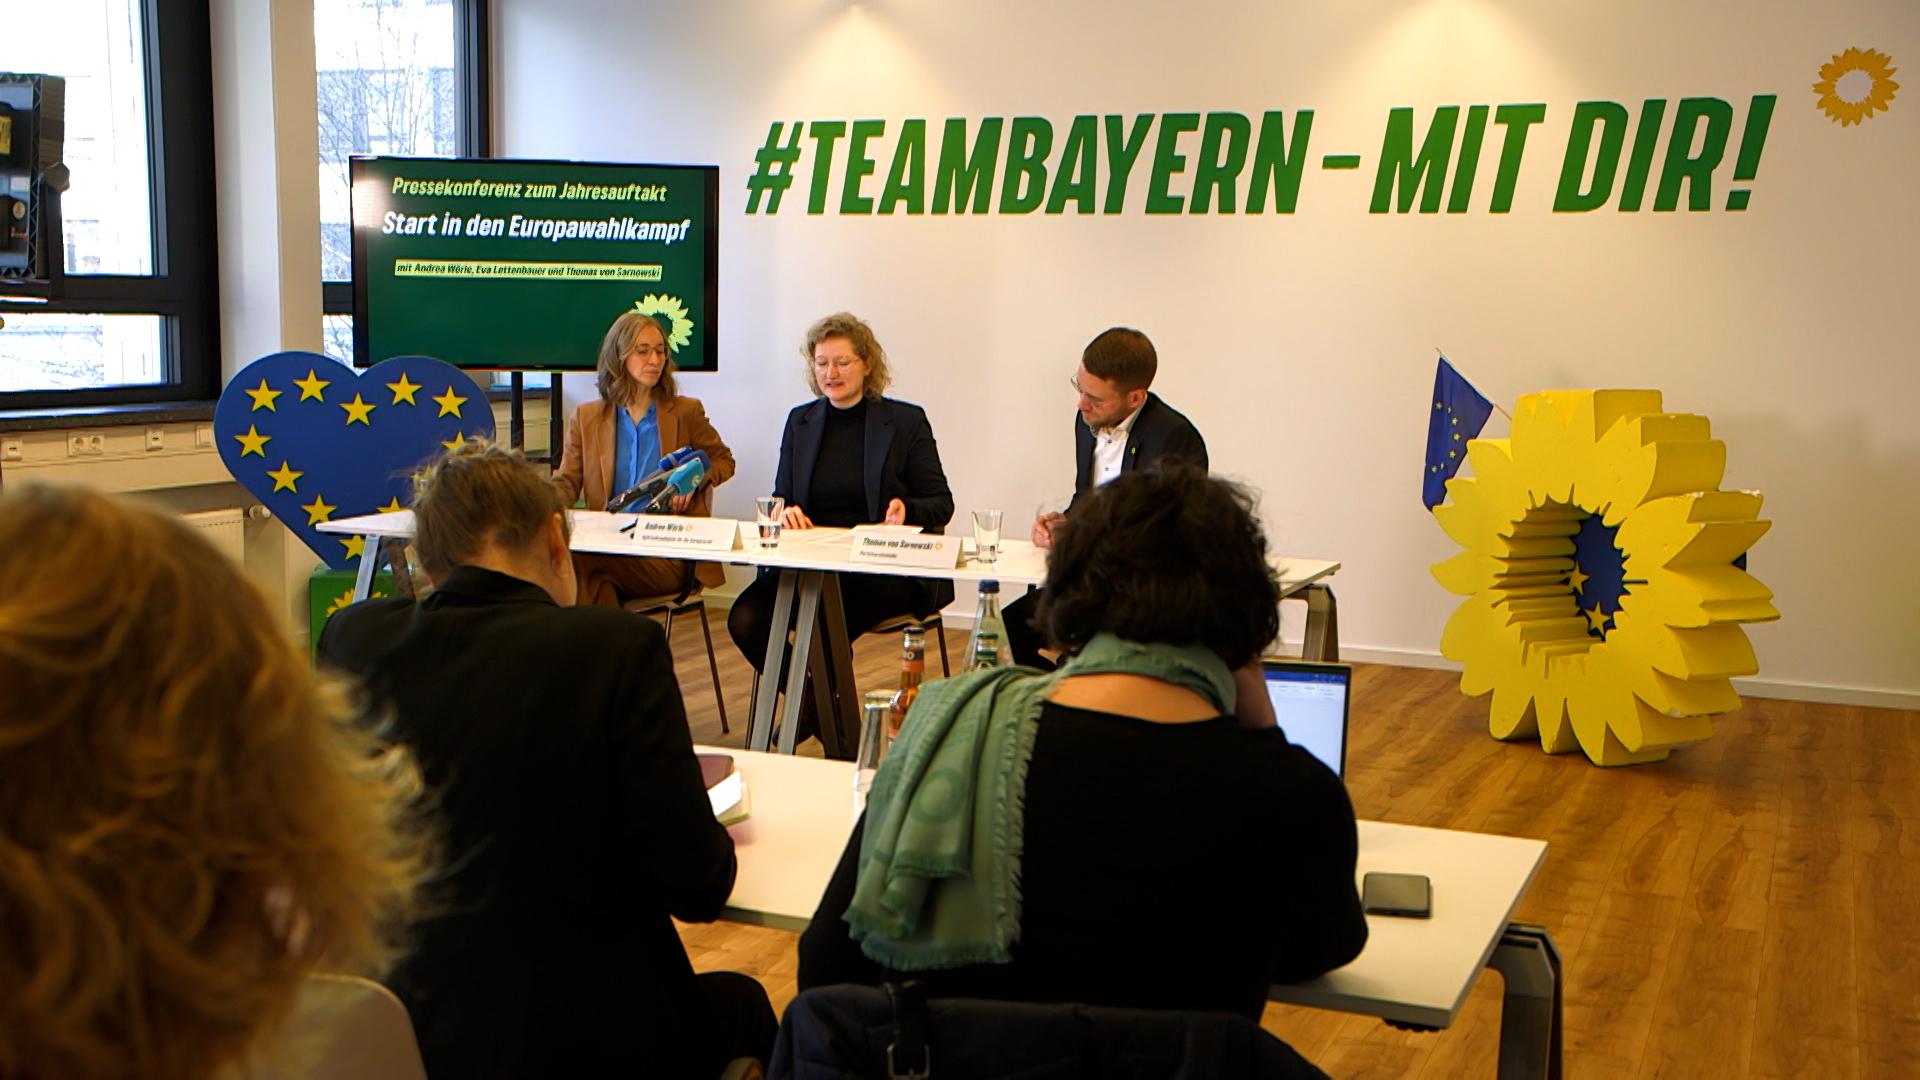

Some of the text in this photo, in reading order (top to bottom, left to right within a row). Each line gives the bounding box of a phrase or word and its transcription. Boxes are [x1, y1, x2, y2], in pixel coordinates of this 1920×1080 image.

[745, 109, 1315, 215] #TEAMBAYERN
[1369, 103, 1547, 214] MIT
[1552, 94, 1777, 213] DIR!
[392, 176, 668, 202] Pressekonferenz zum Jahresauftakt
[382, 210, 691, 246] Start in den Europawahlkampf
[397, 263, 412, 272] mit
[414, 263, 446, 273] Andrea
[476, 265, 492, 274] Eva
[493, 265, 545, 275] Lettenbauer
[547, 267, 564, 275] und
[566, 267, 597, 276] Thomas
[616, 268, 660, 278] Sarnowski
